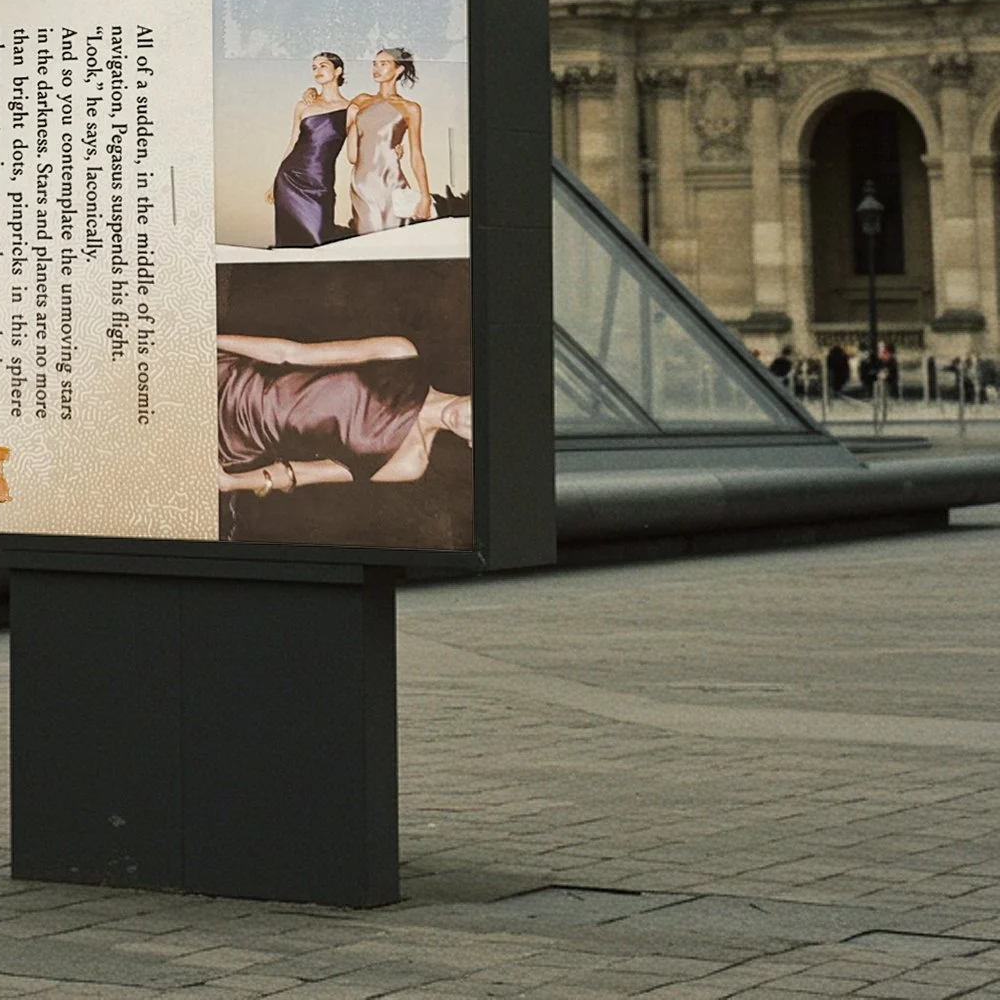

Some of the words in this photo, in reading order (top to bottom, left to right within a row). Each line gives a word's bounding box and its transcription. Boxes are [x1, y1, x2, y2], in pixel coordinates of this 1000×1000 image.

[13, 28, 30, 66] than
[37, 28, 54, 44] in
[61, 27, 78, 61] And
[137, 25, 154, 48] All
[37, 49, 54, 75] the
[61, 69, 73, 87] so
[105, 26, 128, 118] navigation,
[136, 56, 154, 76] of
[7, 76, 29, 129] bright
[136, 80, 148, 89] a
[37, 80, 54, 158] darkness.
[56, 94, 72, 125] you
[86, 97, 103, 117] he
[81, 122, 97, 161] says,
[134, 96, 154, 164] sudden,
[10, 139, 29, 181] dots,
[106, 124, 128, 190] Pegasus
[36, 163, 53, 205] Stars
[56, 133, 78, 240] contemplate
[137, 172, 154, 189] in
[36, 209, 53, 240] and
[80, 166, 103, 262] laconically.
[137, 196, 154, 225] the
[7, 192, 29, 275] pinpricks
[106, 195, 129, 274] suspends
[31, 246, 53, 308] planets
[61, 248, 78, 276] the
[137, 233, 155, 295] middle
[12, 286, 28, 303] in
[111, 280, 129, 305] his
[11, 314, 28, 346] this
[36, 312, 47, 340] are
[55, 284, 78, 374] unmoving
[137, 303, 155, 324] of
[106, 311, 129, 362] flight.
[137, 329, 155, 354] his
[36, 345, 47, 368] no
[6, 357, 28, 417] sphere
[35, 373, 47, 419] more
[60, 380, 73, 420] stars
[137, 362, 155, 425] cosmic
